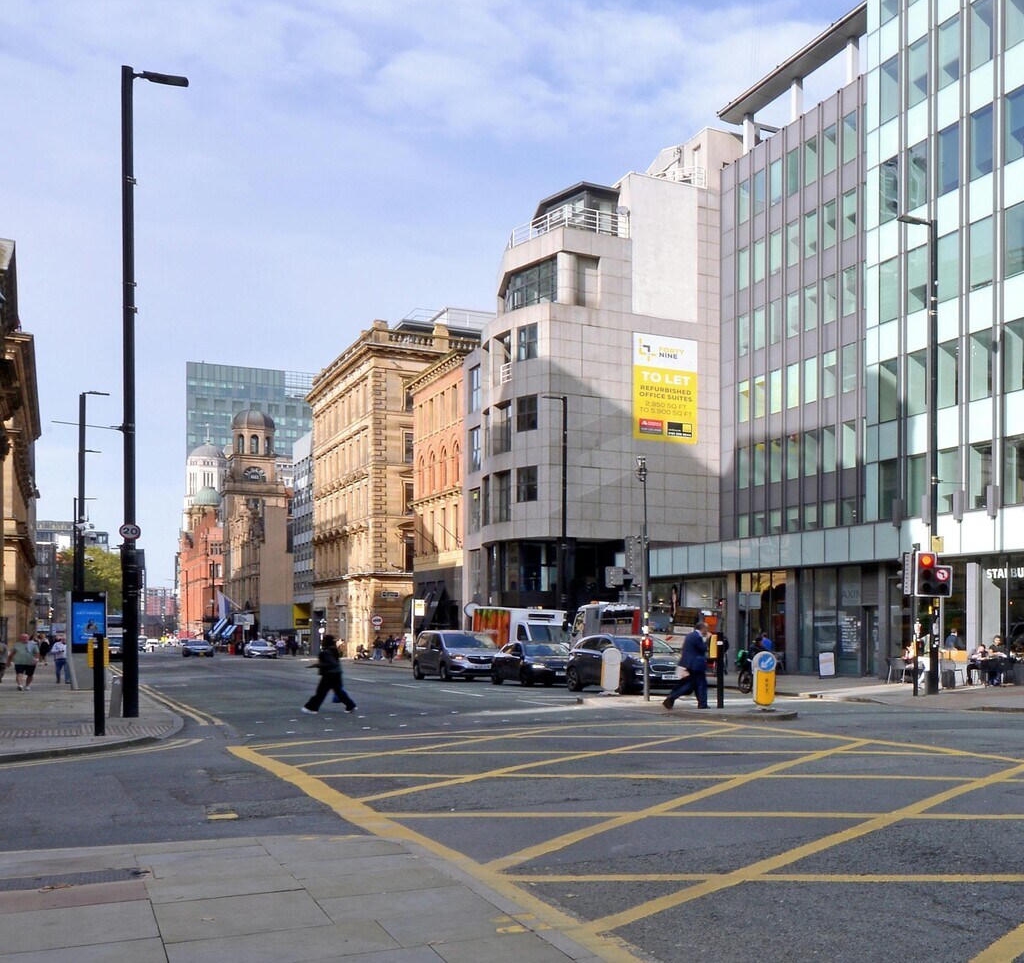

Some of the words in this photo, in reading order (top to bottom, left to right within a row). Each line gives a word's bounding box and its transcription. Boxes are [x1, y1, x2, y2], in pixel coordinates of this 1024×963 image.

[659, 347, 684, 355] FORTY
[641, 371, 662, 383] TO
[665, 374, 691, 386] LET
[640, 385, 692, 396] REFURBISHED
[639, 392, 666, 400] OFFICE
[667, 395, 693, 403] SUITES
[122, 527, 138, 535] 20
